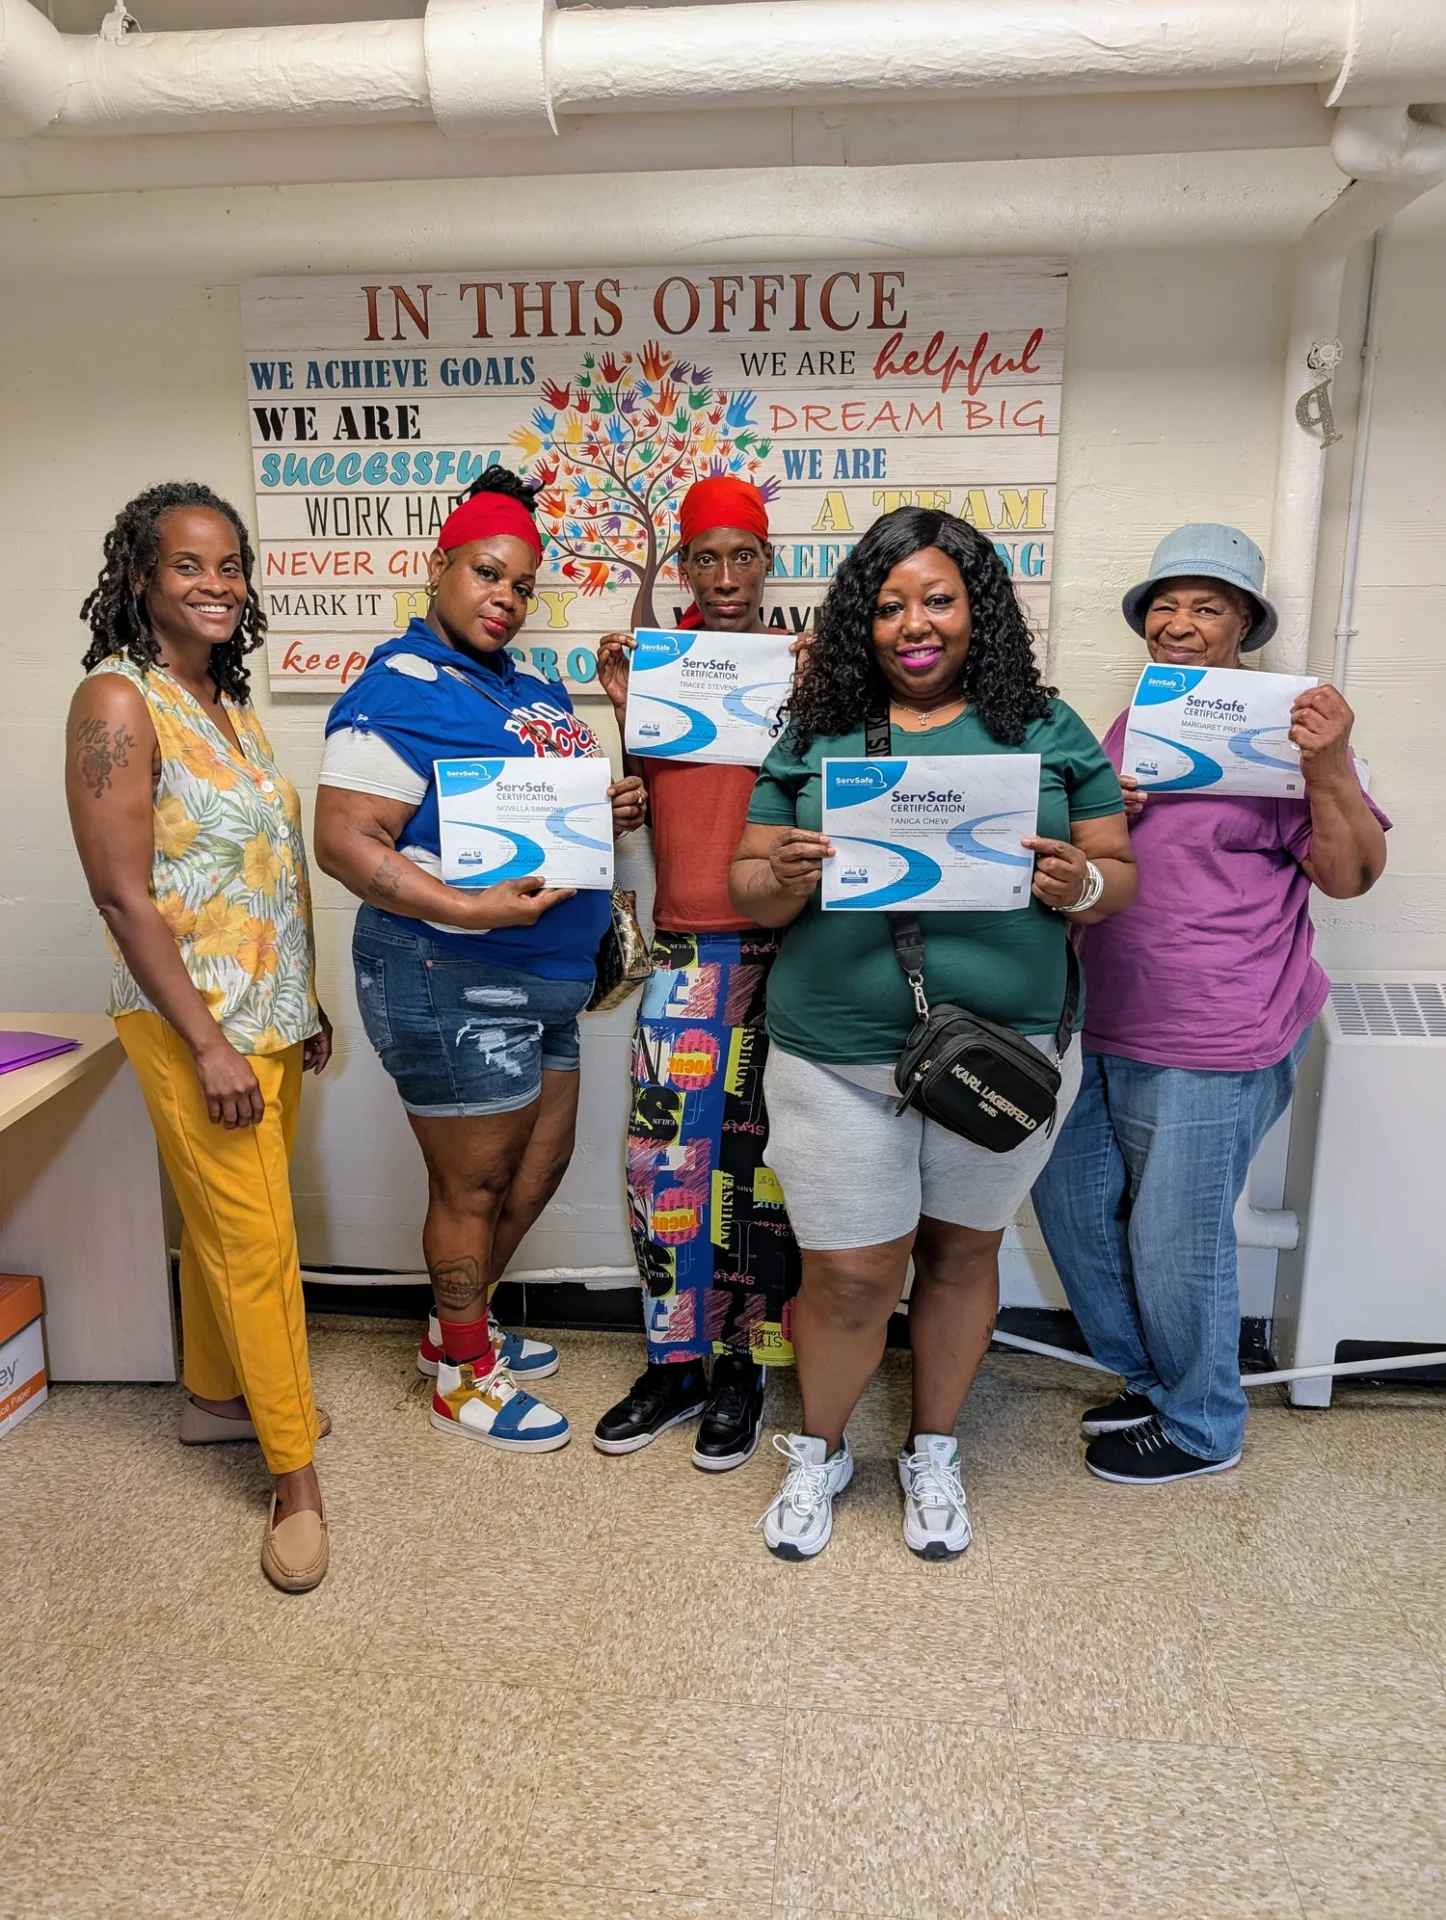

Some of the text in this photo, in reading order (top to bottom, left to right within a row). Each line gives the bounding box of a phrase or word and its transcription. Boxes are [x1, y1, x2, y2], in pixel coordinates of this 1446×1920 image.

[360, 271, 908, 341] IN THIS OFFICE
[740, 327, 1044, 396] WE ARE helpful
[249, 355, 537, 391] WE ACHIEVE GOALS
[252, 404, 422, 442] WE ARE
[769, 400, 1045, 437] DREAM BIG
[782, 448, 887, 480] WE ARE
[305, 496, 393, 536] WORK
[811, 490, 854, 531] A
[267, 550, 374, 576] NEVER
[270, 594, 348, 616] MARK
[357, 594, 382, 616] IT
[642, 643, 671, 652] ServSafe
[282, 641, 366, 684] keep
[682, 657, 737, 672] ServSafe
[681, 669, 738, 681] CERTIFICATION
[1148, 677, 1177, 688] ServSafe
[679, 681, 738, 692] TRACEE STEVENS
[1186, 695, 1245, 713] ServSafe
[1183, 707, 1247, 723] CERTIFICATION
[1181, 719, 1222, 732] MARGARET
[496, 781, 554, 793] ServSafe
[836, 776, 874, 785] ServSafe
[496, 792, 558, 802] CERTIFICATION
[891, 789, 962, 803] ServSafe
[496, 805, 564, 814] NOVELLA SIMMONS
[890, 804, 965, 814] CERTIFICATION
[890, 817, 950, 825] TANICA CHEW
[666, 1057, 713, 1075] VOGUE
[951, 1064, 1037, 1131] KARL LAGERFELD
[978, 1100, 998, 1118] PARIS
[650, 1214, 699, 1232] VOGUE
